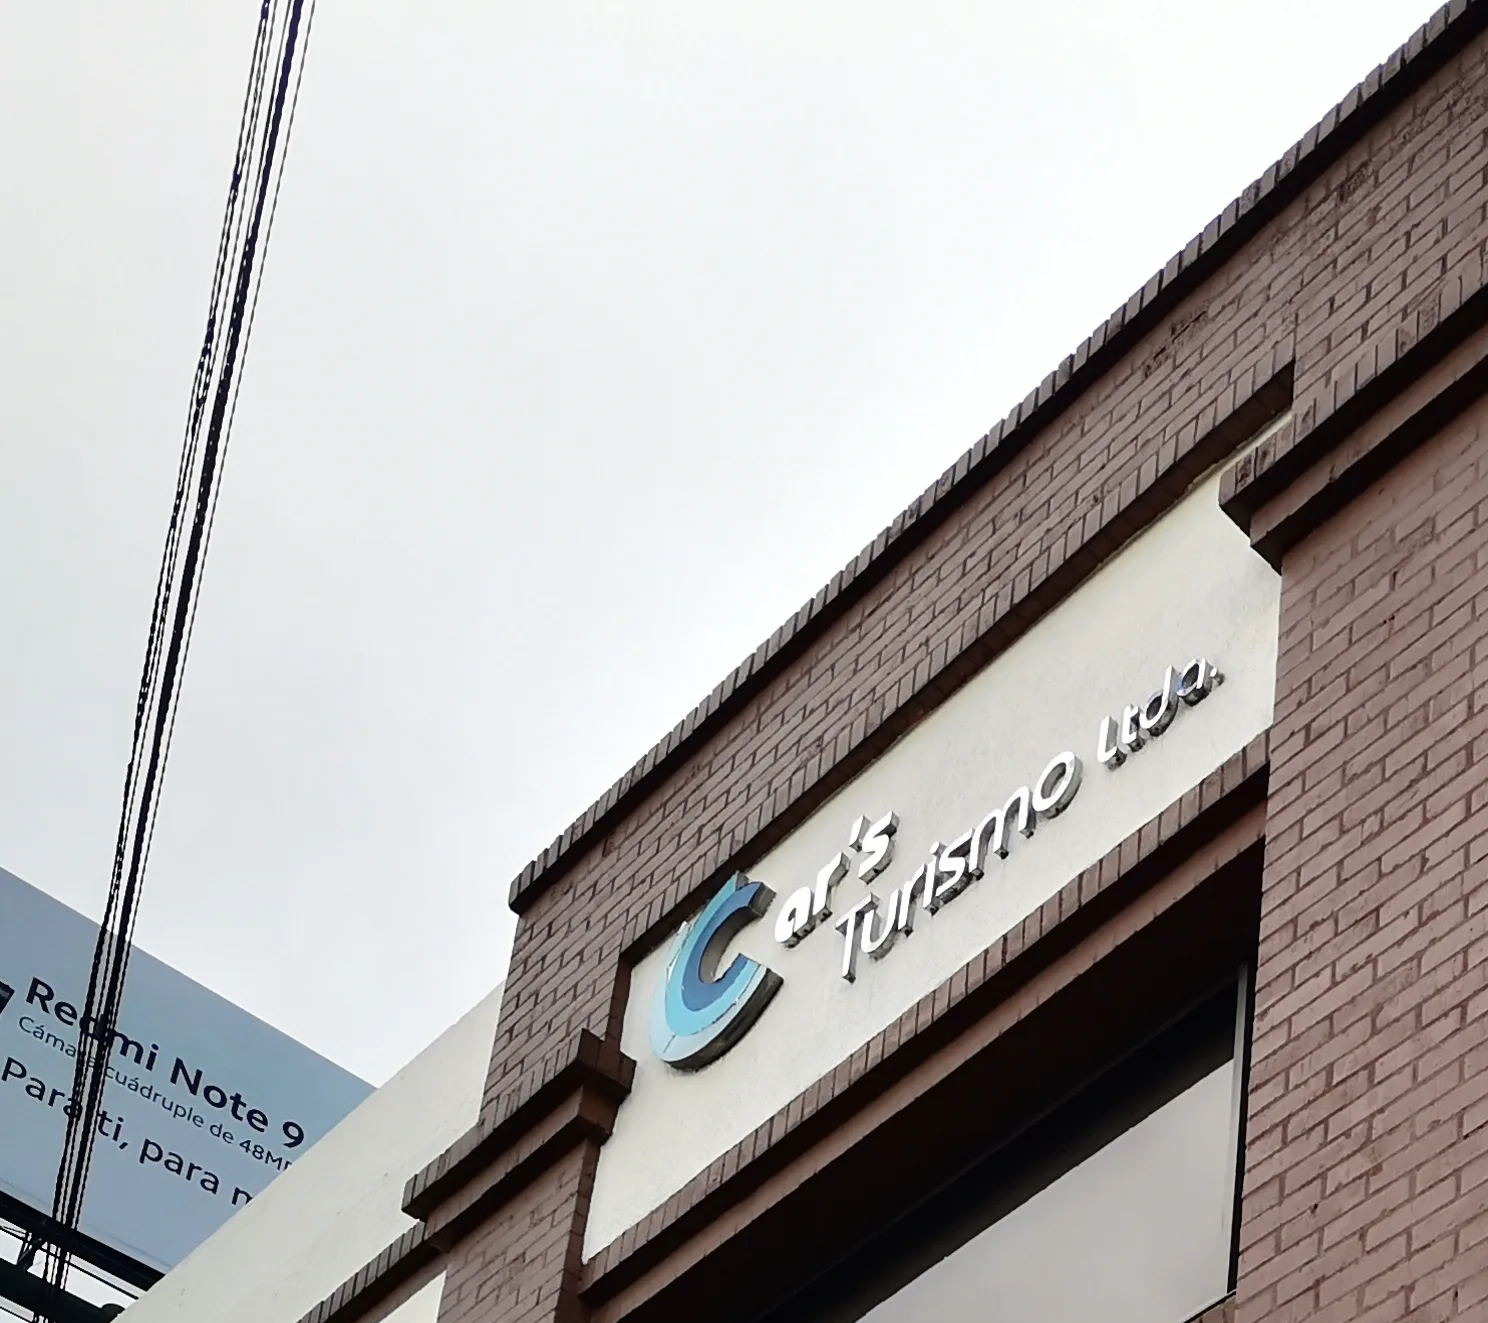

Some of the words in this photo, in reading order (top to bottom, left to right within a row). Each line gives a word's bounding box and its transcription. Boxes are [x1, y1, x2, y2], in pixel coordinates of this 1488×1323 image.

[834, 750, 1084, 983] Turismo
[1096, 655, 1225, 770] Ltda.
[1, 1056, 83, 1122] Para
[97, 1109, 129, 1152] ti,
[139, 1137, 220, 1195] para
[104, 1065, 205, 1128] cuádruple
[209, 1123, 234, 1144] de
[170, 1057, 270, 1133] Note
[282, 1120, 305, 1149] 9
